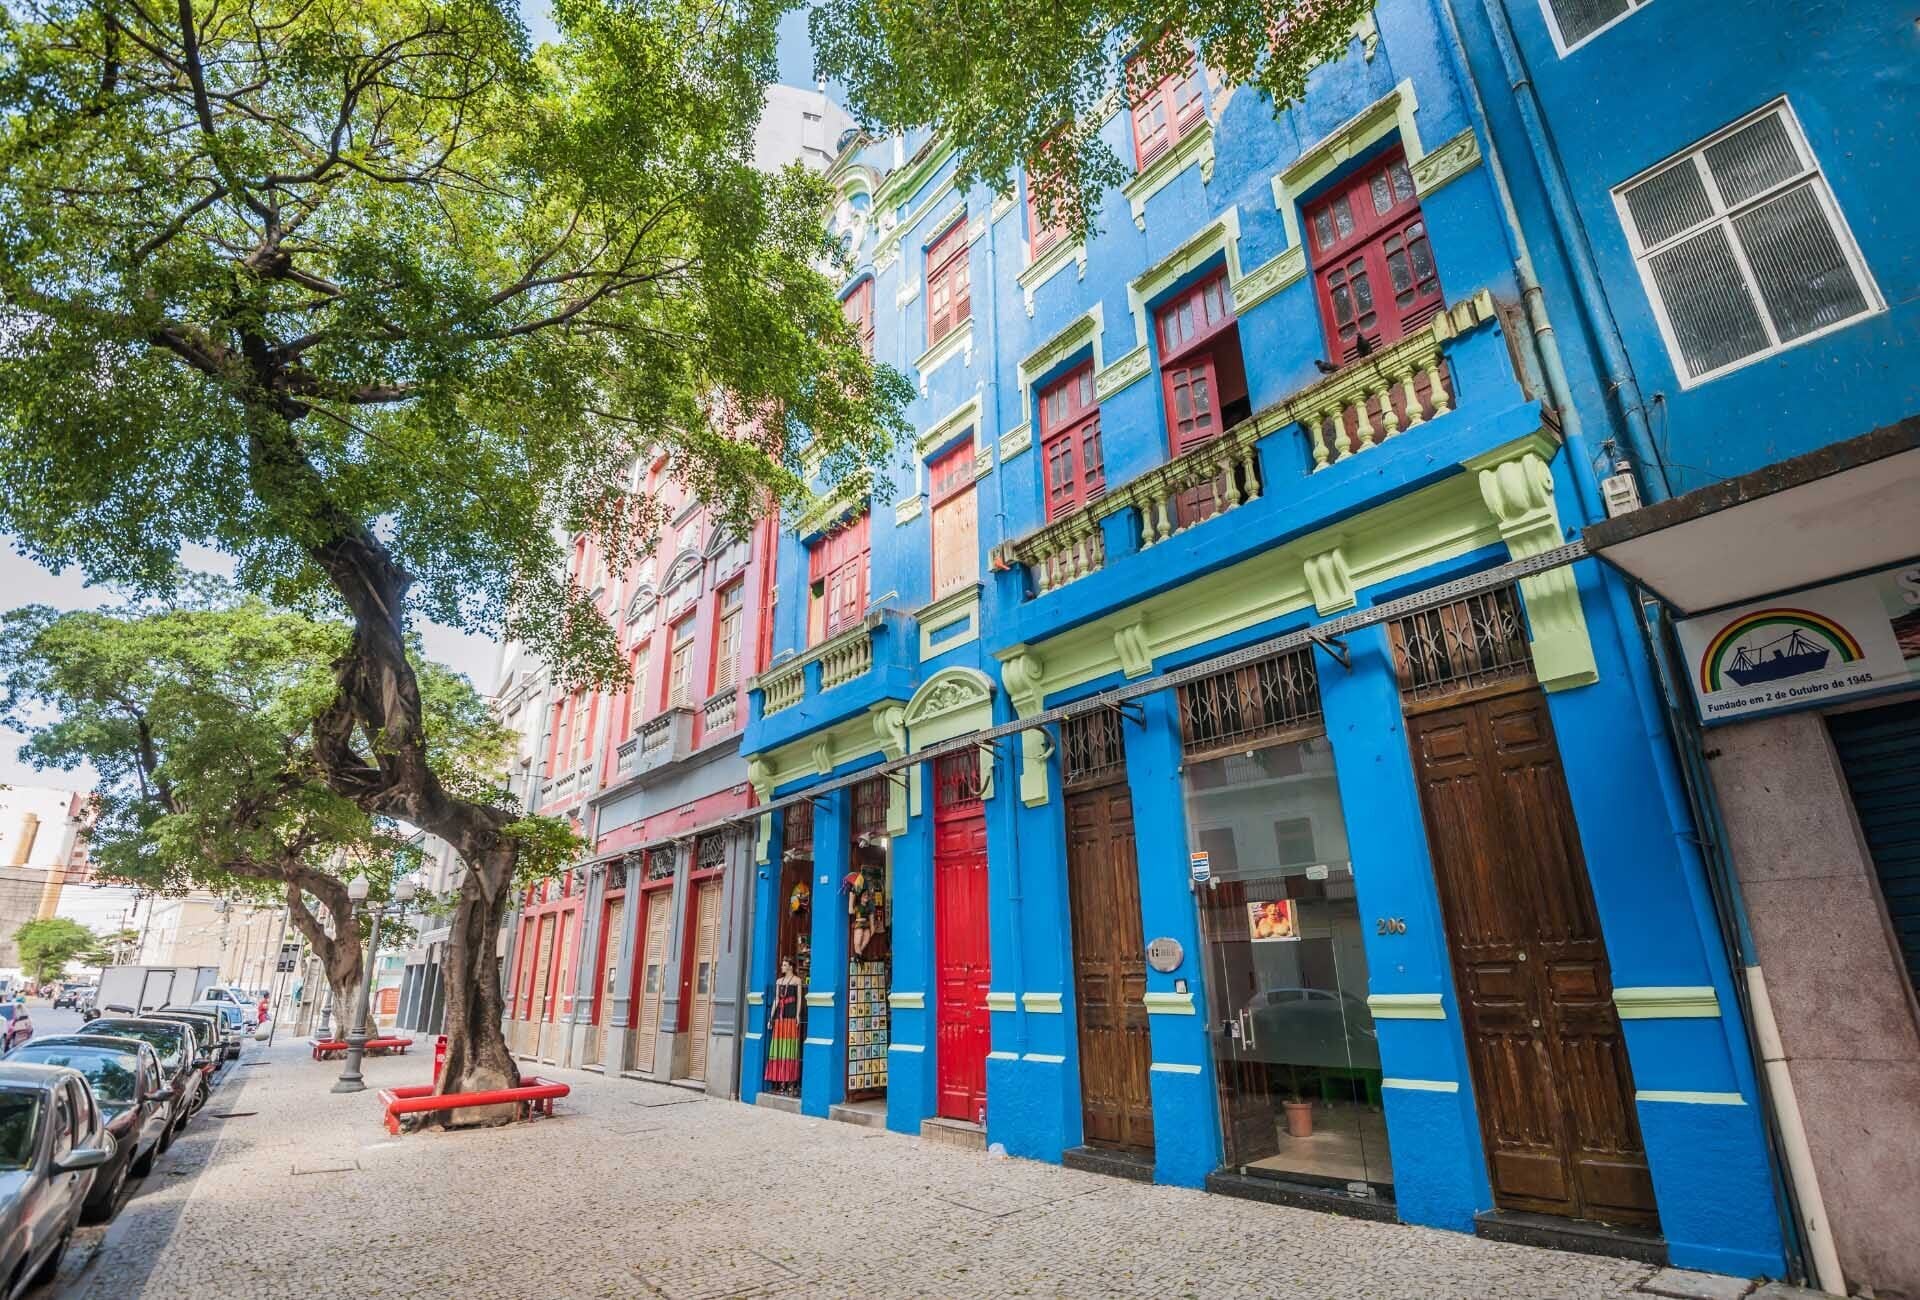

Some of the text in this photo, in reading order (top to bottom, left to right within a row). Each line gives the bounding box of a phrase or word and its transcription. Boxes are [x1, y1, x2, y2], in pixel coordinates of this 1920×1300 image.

[1707, 673, 1873, 713] Fundado em 2 de Outubro de 1945
[1376, 918, 1407, 935] 206
